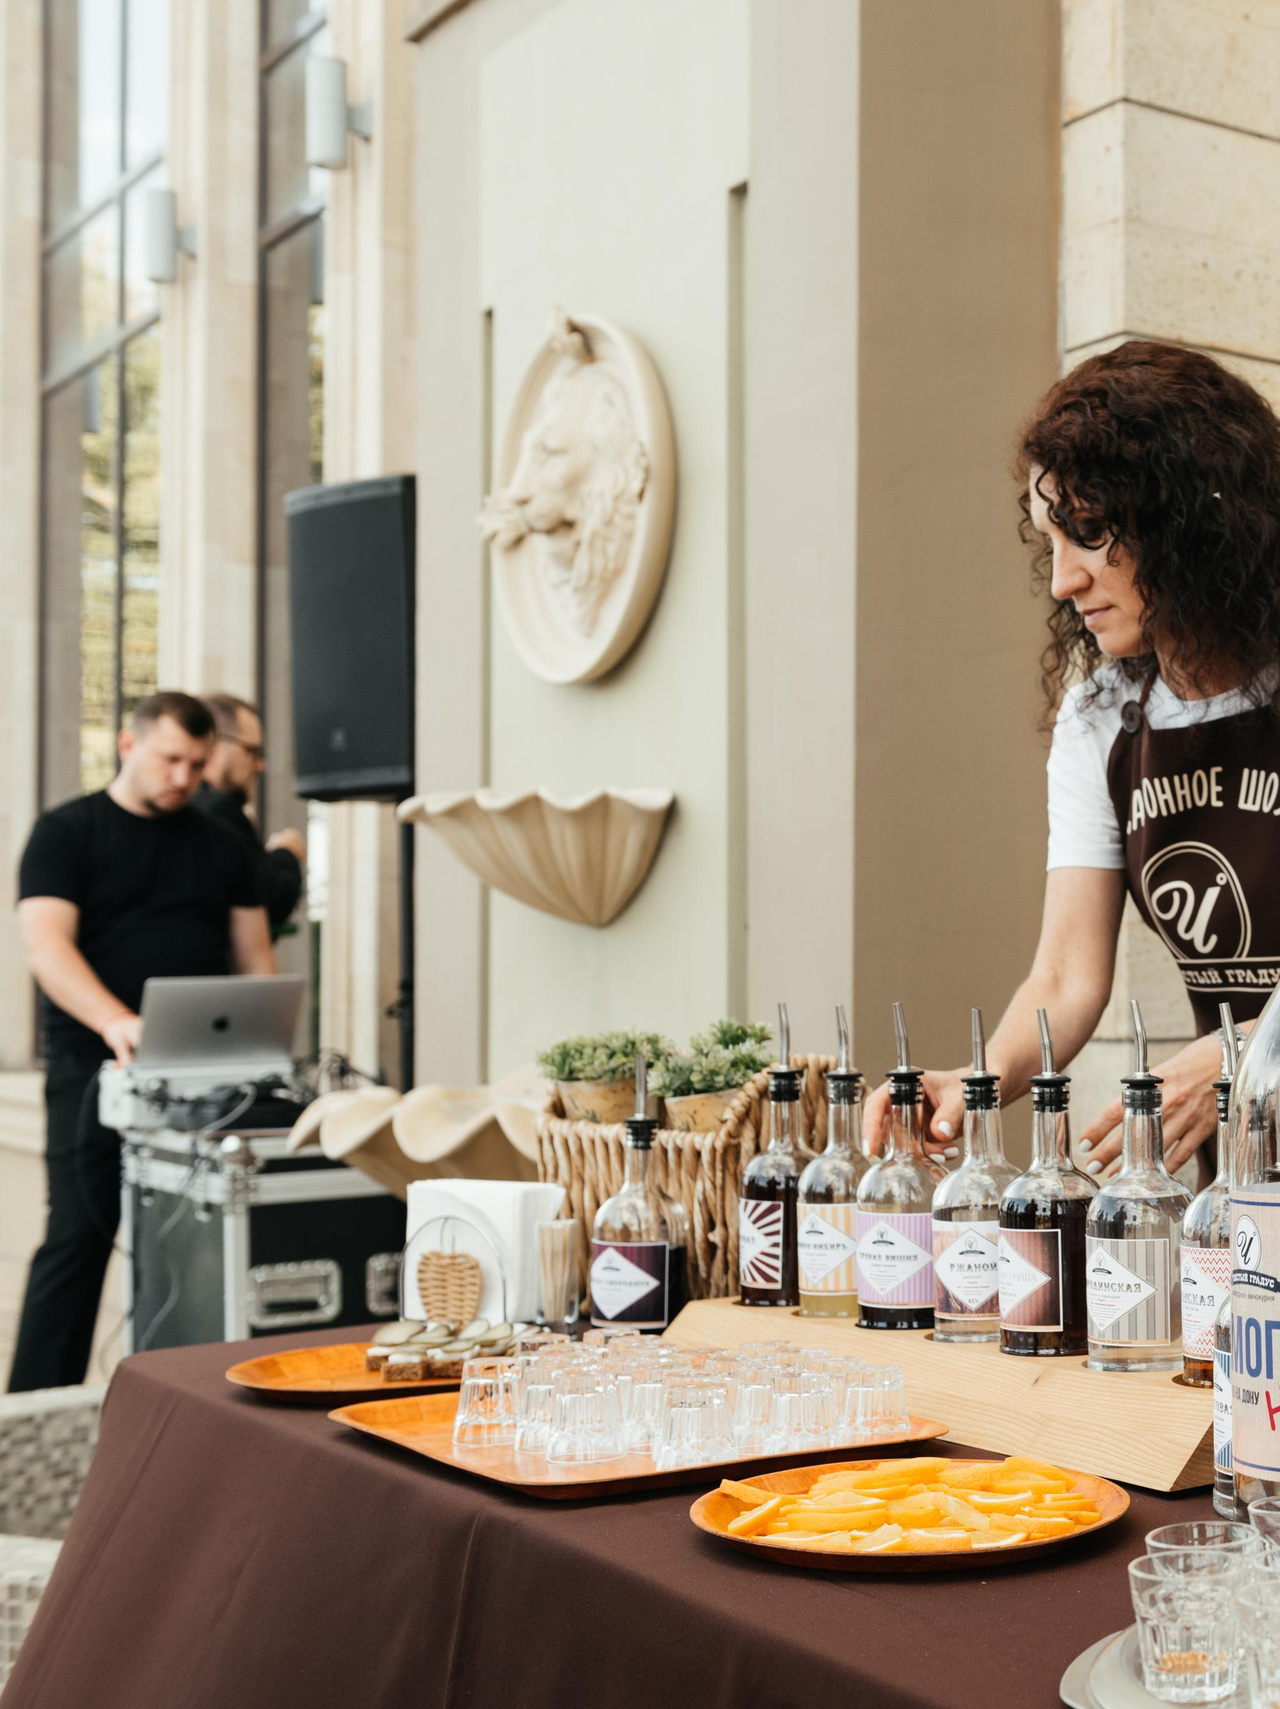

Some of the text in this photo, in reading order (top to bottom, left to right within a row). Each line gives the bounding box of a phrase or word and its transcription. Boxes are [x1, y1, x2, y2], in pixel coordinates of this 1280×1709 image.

[1182, 968, 1222, 985] СТЫЙ
[949, 1260, 998, 1272] РЖАНОЙ
[1249, 1274, 1275, 1289] ГРАДУС
